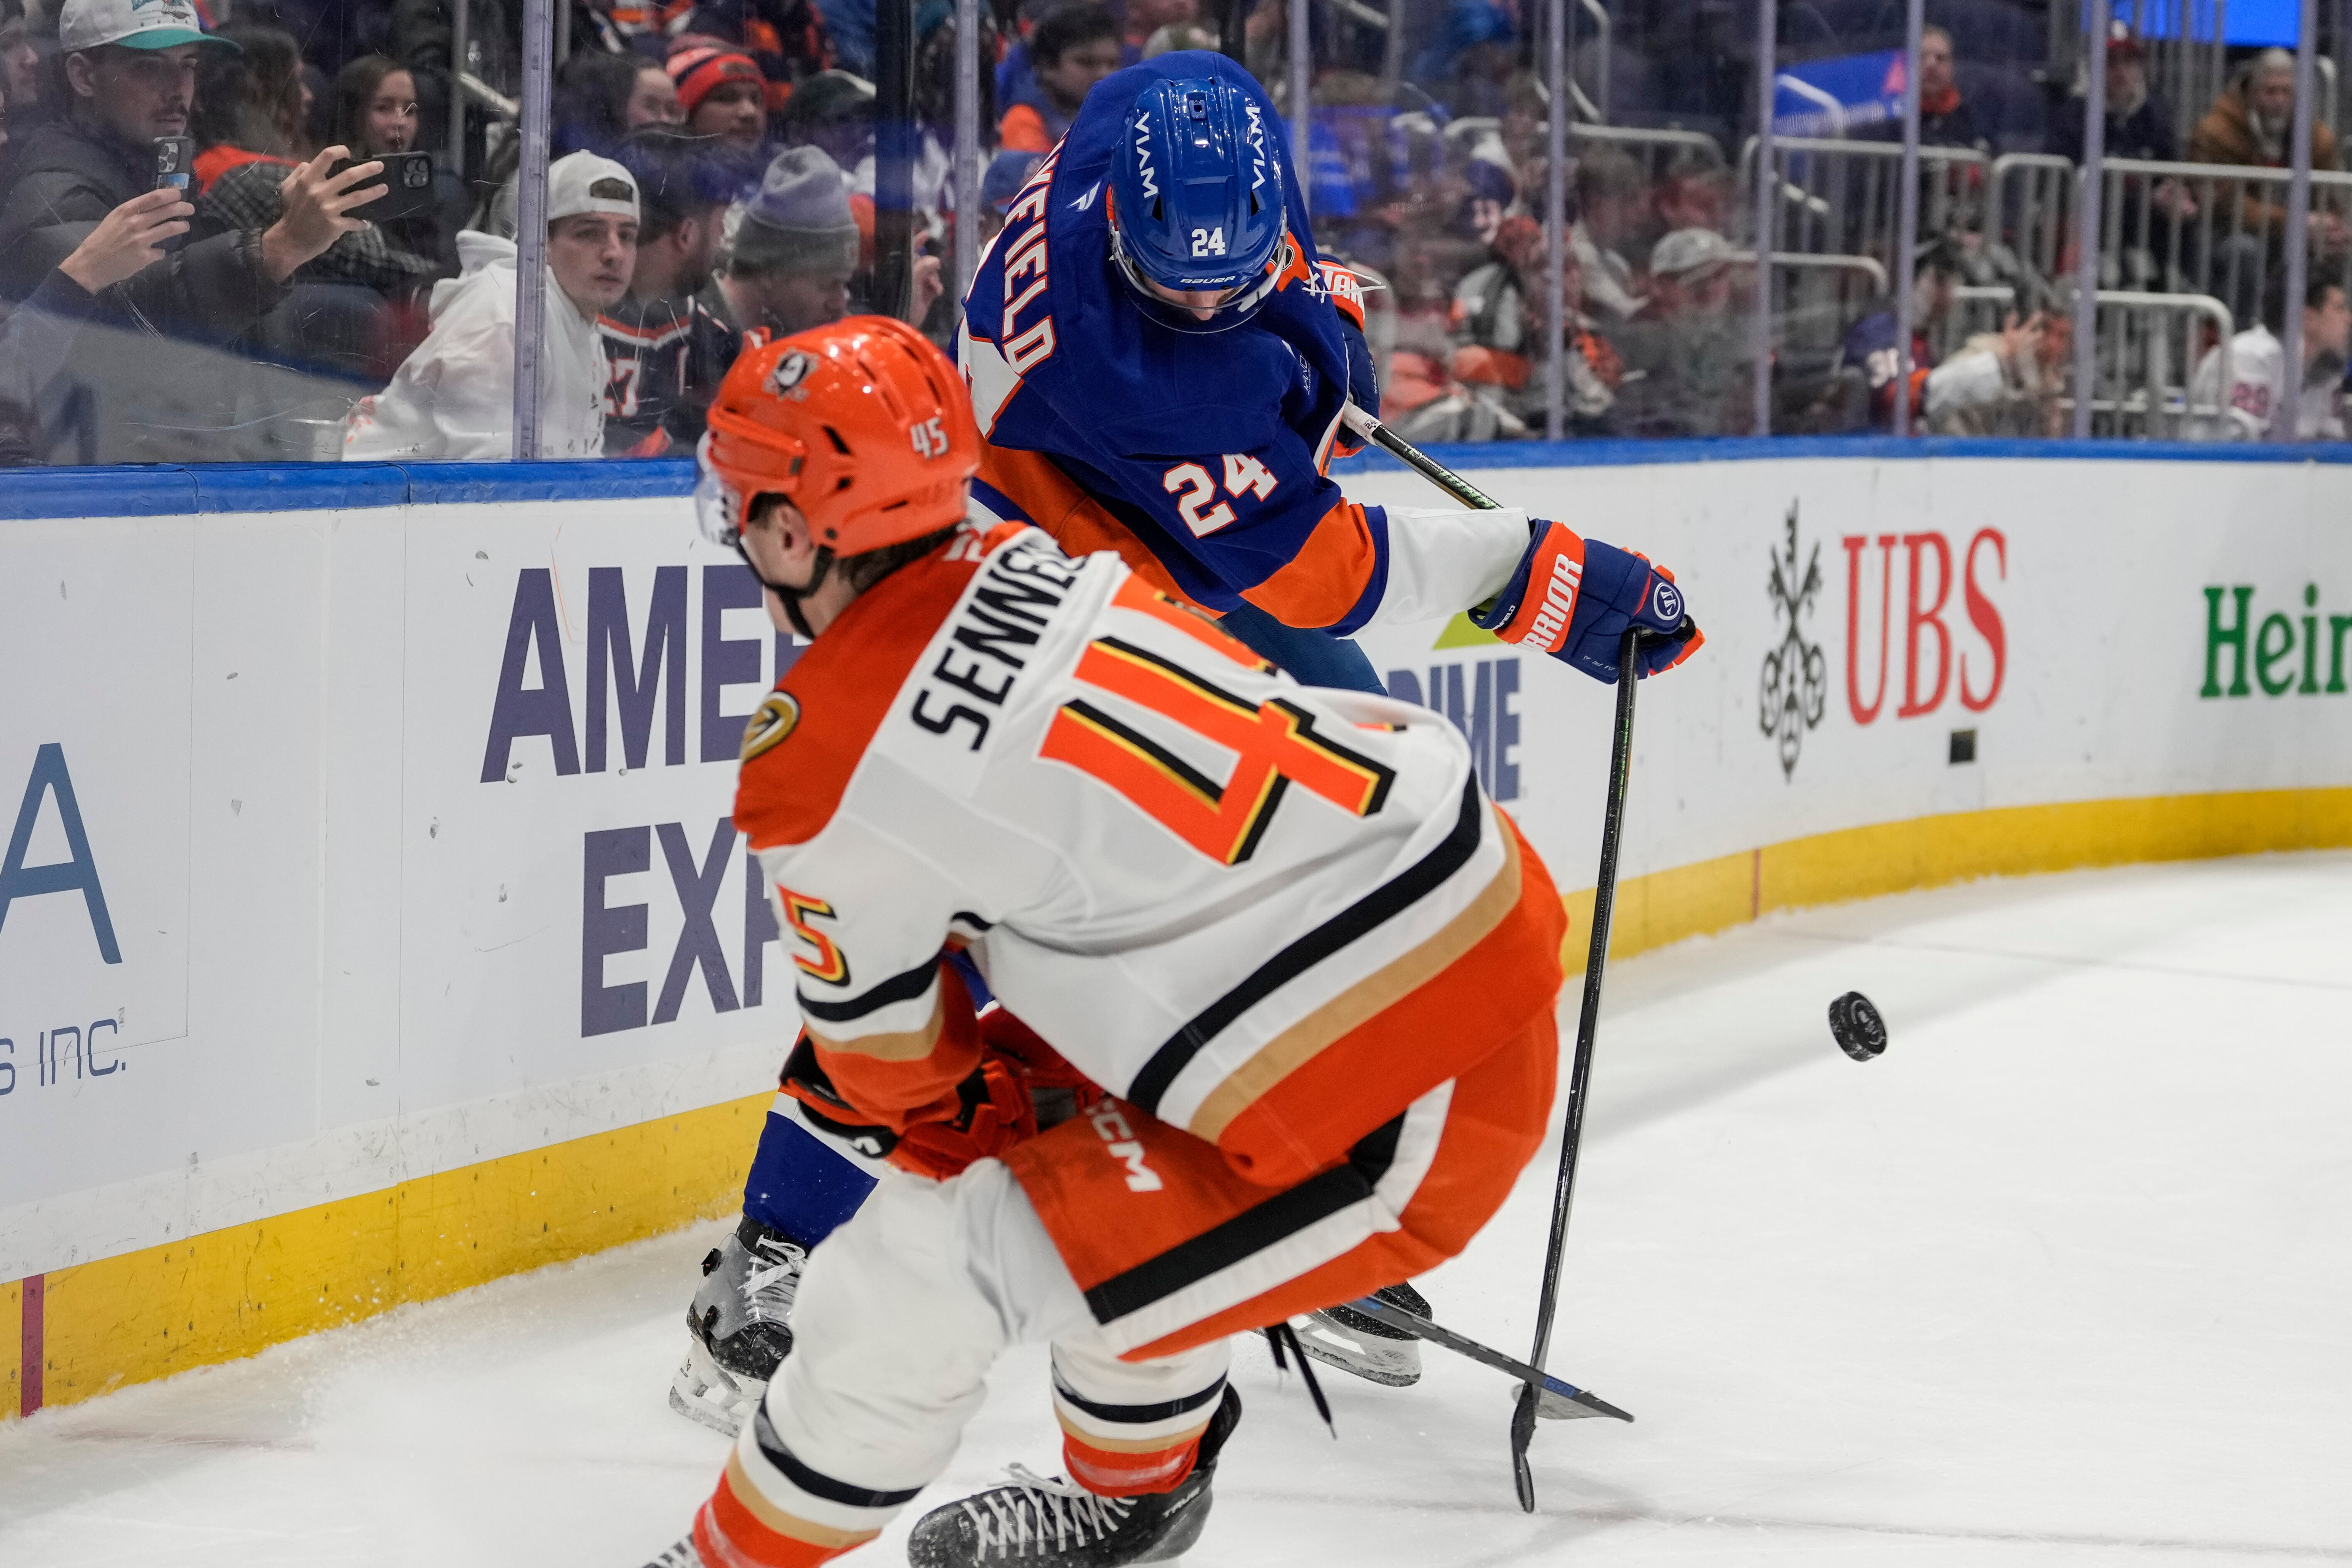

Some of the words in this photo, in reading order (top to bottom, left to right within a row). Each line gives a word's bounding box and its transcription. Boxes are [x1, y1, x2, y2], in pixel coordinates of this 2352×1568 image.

[1134, 111, 1158, 198] VIAM
[1246, 106, 1265, 190] VIAM
[1001, 135, 1065, 375] YFIELD
[1180, 275, 1236, 284] BAUER
[1192, 227, 1226, 257] 24
[910, 417, 950, 459] 45
[1163, 453, 1279, 539] 24
[911, 541, 1088, 752] SENNE
[1513, 553, 1582, 652] RRIOR
[1843, 527, 2007, 726] UBS
[480, 565, 814, 783] AME
[1037, 574, 1398, 867] 4
